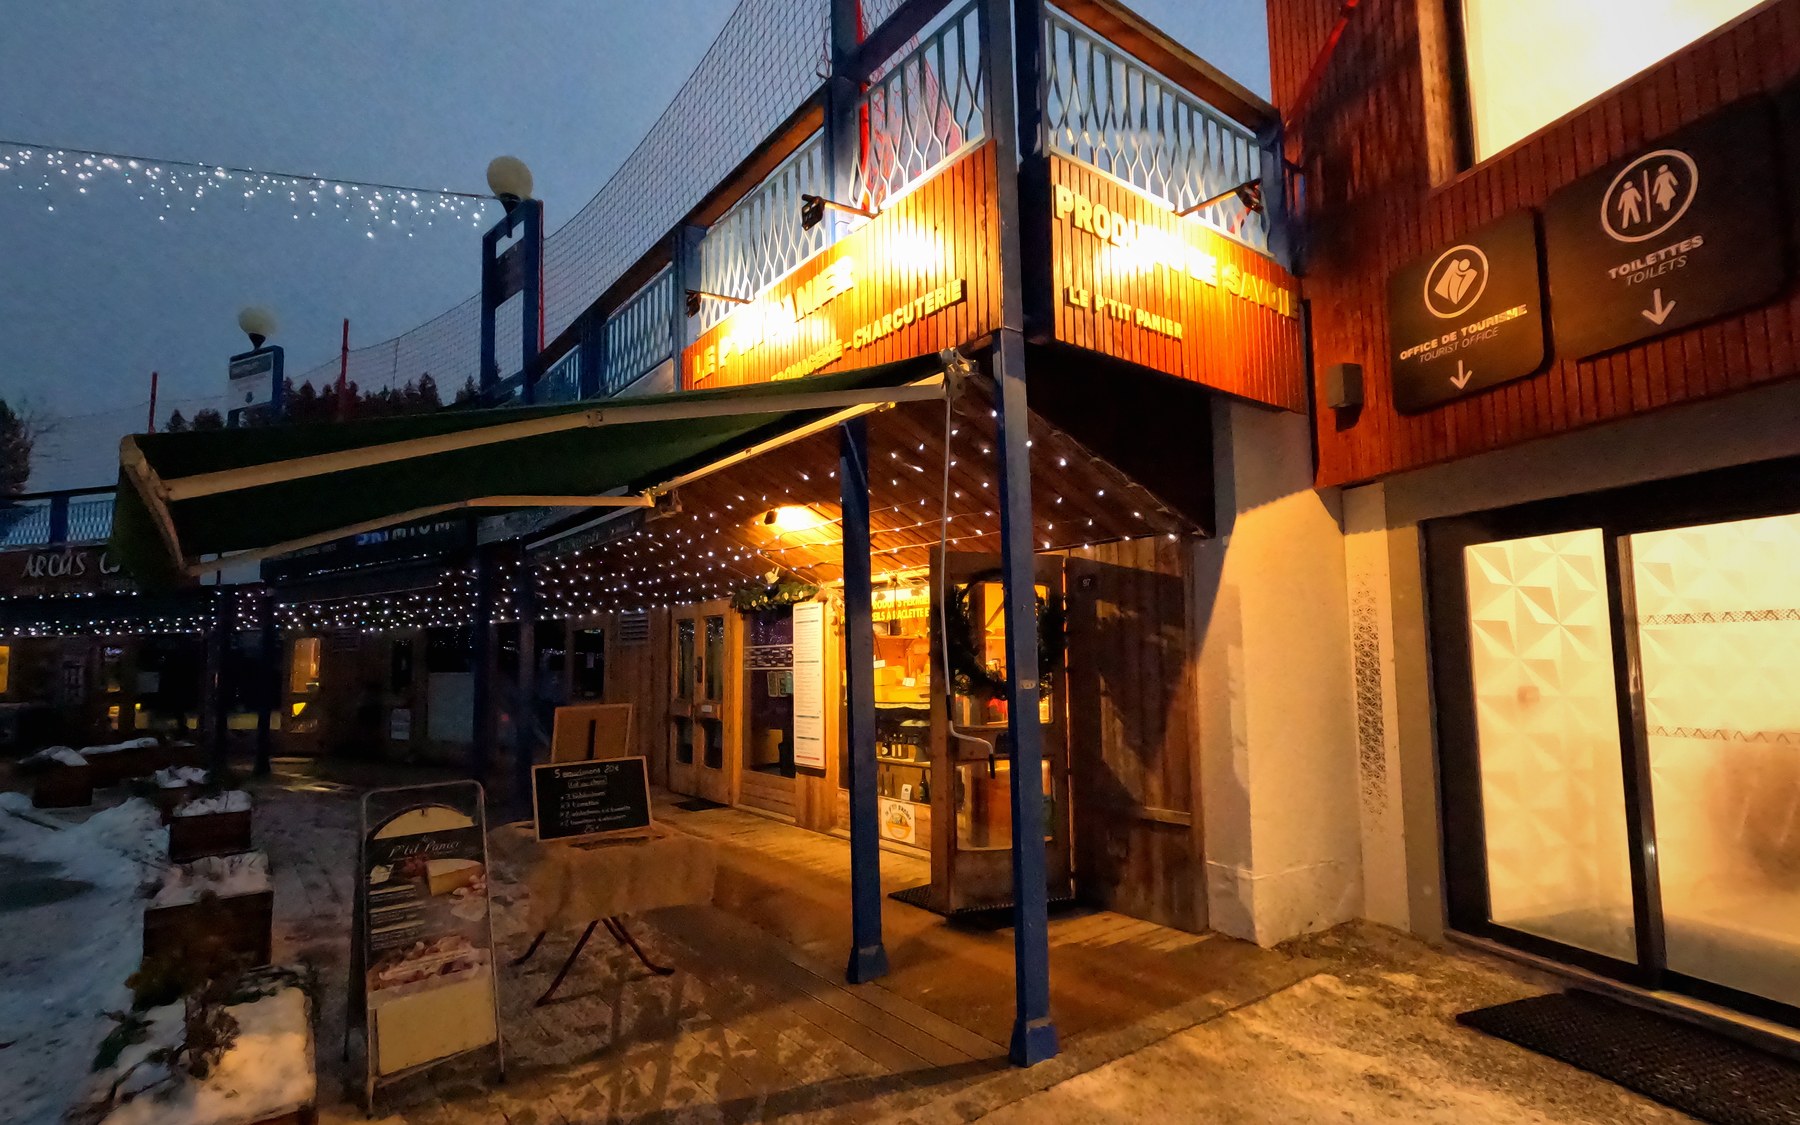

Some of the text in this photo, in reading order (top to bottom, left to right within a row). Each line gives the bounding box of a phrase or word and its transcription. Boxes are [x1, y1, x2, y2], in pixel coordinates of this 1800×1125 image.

[1608, 235, 1704, 279] TOILETTES
[1626, 255, 1688, 286] TOILETS
[1067, 285, 1183, 339] LE P'TIT PANIER
[1225, 263, 1299, 319] SAVOIE
[1399, 304, 1529, 360] OFFICE DE TOURISME
[1419, 326, 1500, 363] TOURIST OFFICE
[424, 840, 461, 853] Panier
